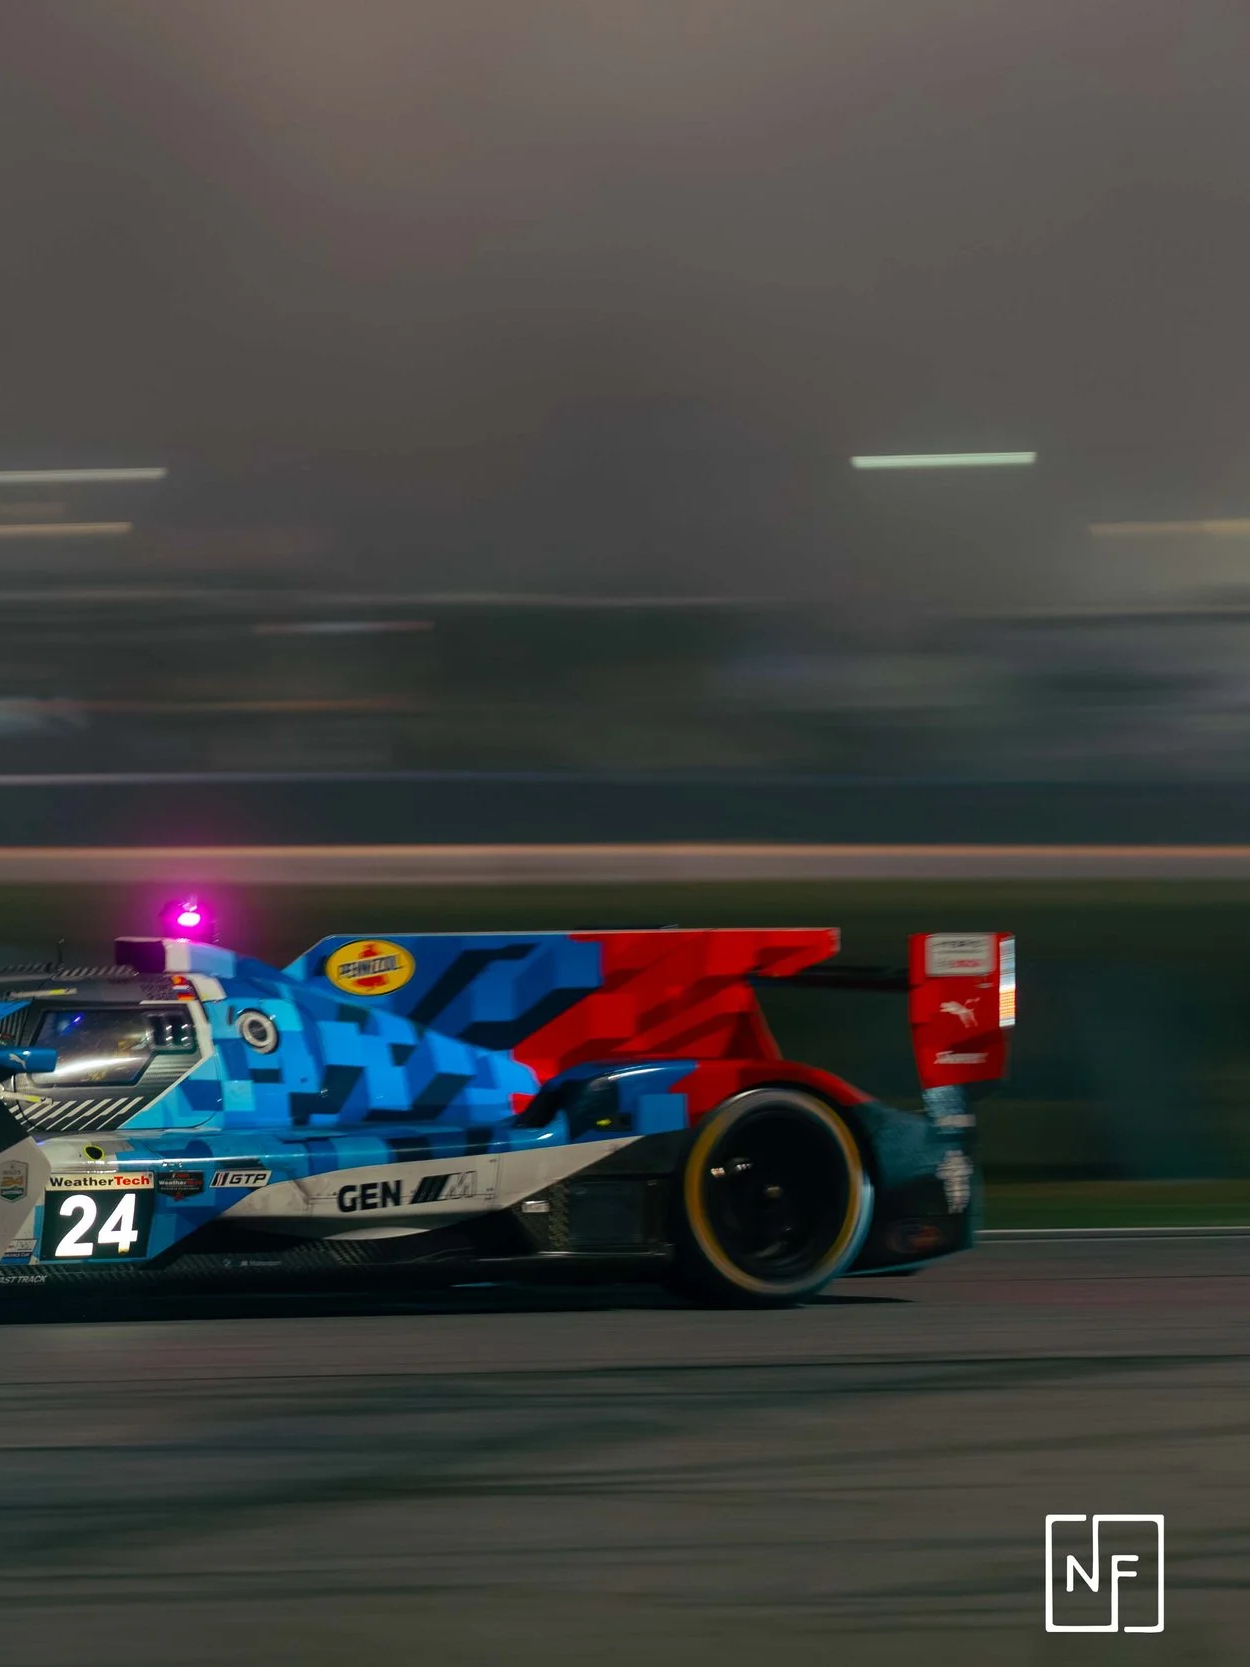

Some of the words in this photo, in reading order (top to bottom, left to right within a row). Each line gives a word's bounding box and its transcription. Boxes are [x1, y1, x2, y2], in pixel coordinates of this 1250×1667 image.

[50, 1175, 149, 1187] WeatherTech
[229, 1172, 267, 1185] GTP
[337, 1179, 403, 1213] GEN
[55, 1193, 138, 1257] 24
[17, 1275, 47, 1283] TRACK
